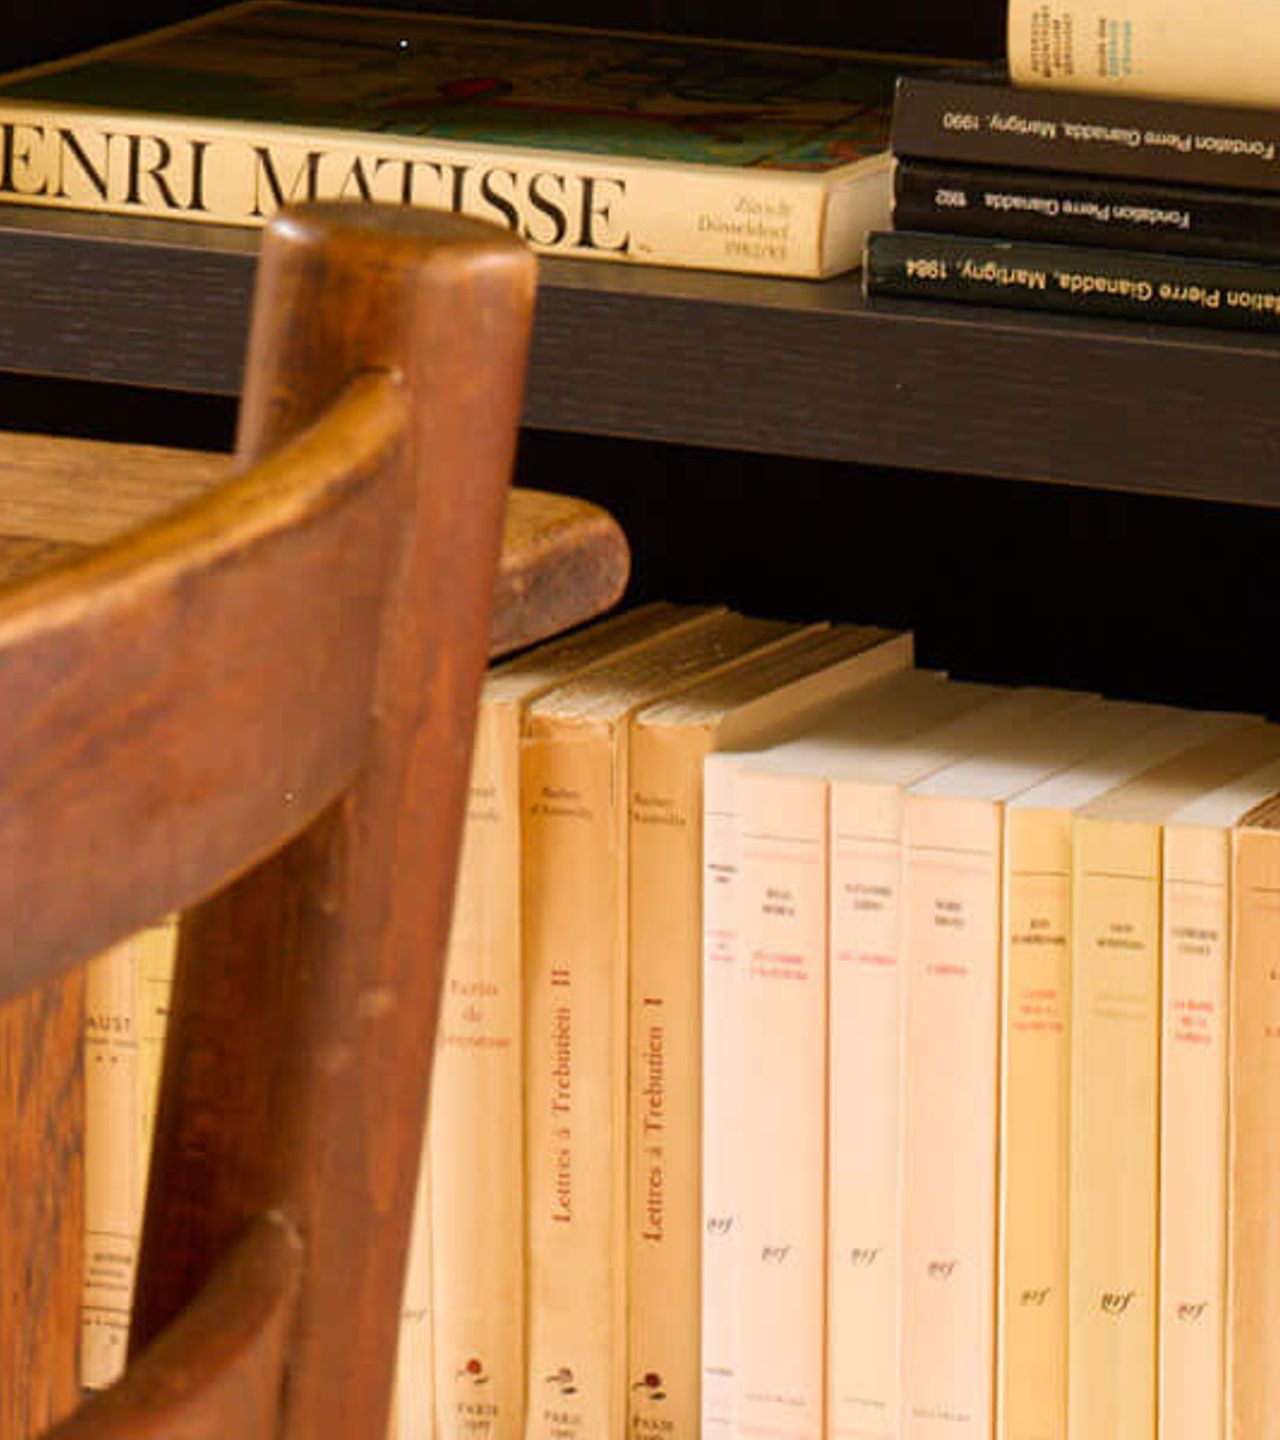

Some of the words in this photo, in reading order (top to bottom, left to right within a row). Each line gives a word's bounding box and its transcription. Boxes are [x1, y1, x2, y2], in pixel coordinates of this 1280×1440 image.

[943, 112, 979, 130] 1990
[1145, 131, 1192, 152] Pierre
[1195, 137, 1274, 160] Fondation
[252, 145, 633, 254] MATISSE
[1063, 200, 1112, 221] Pierre
[1113, 206, 1190, 230] Fondation
[906, 259, 947, 279] 1984
[1160, 282, 1220, 308] Pierre
[551, 969, 571, 987] II
[84, 1013, 131, 1033] AUST
[551, 1148, 571, 1224] Lettres
[642, 1166, 664, 1242] Lettres
